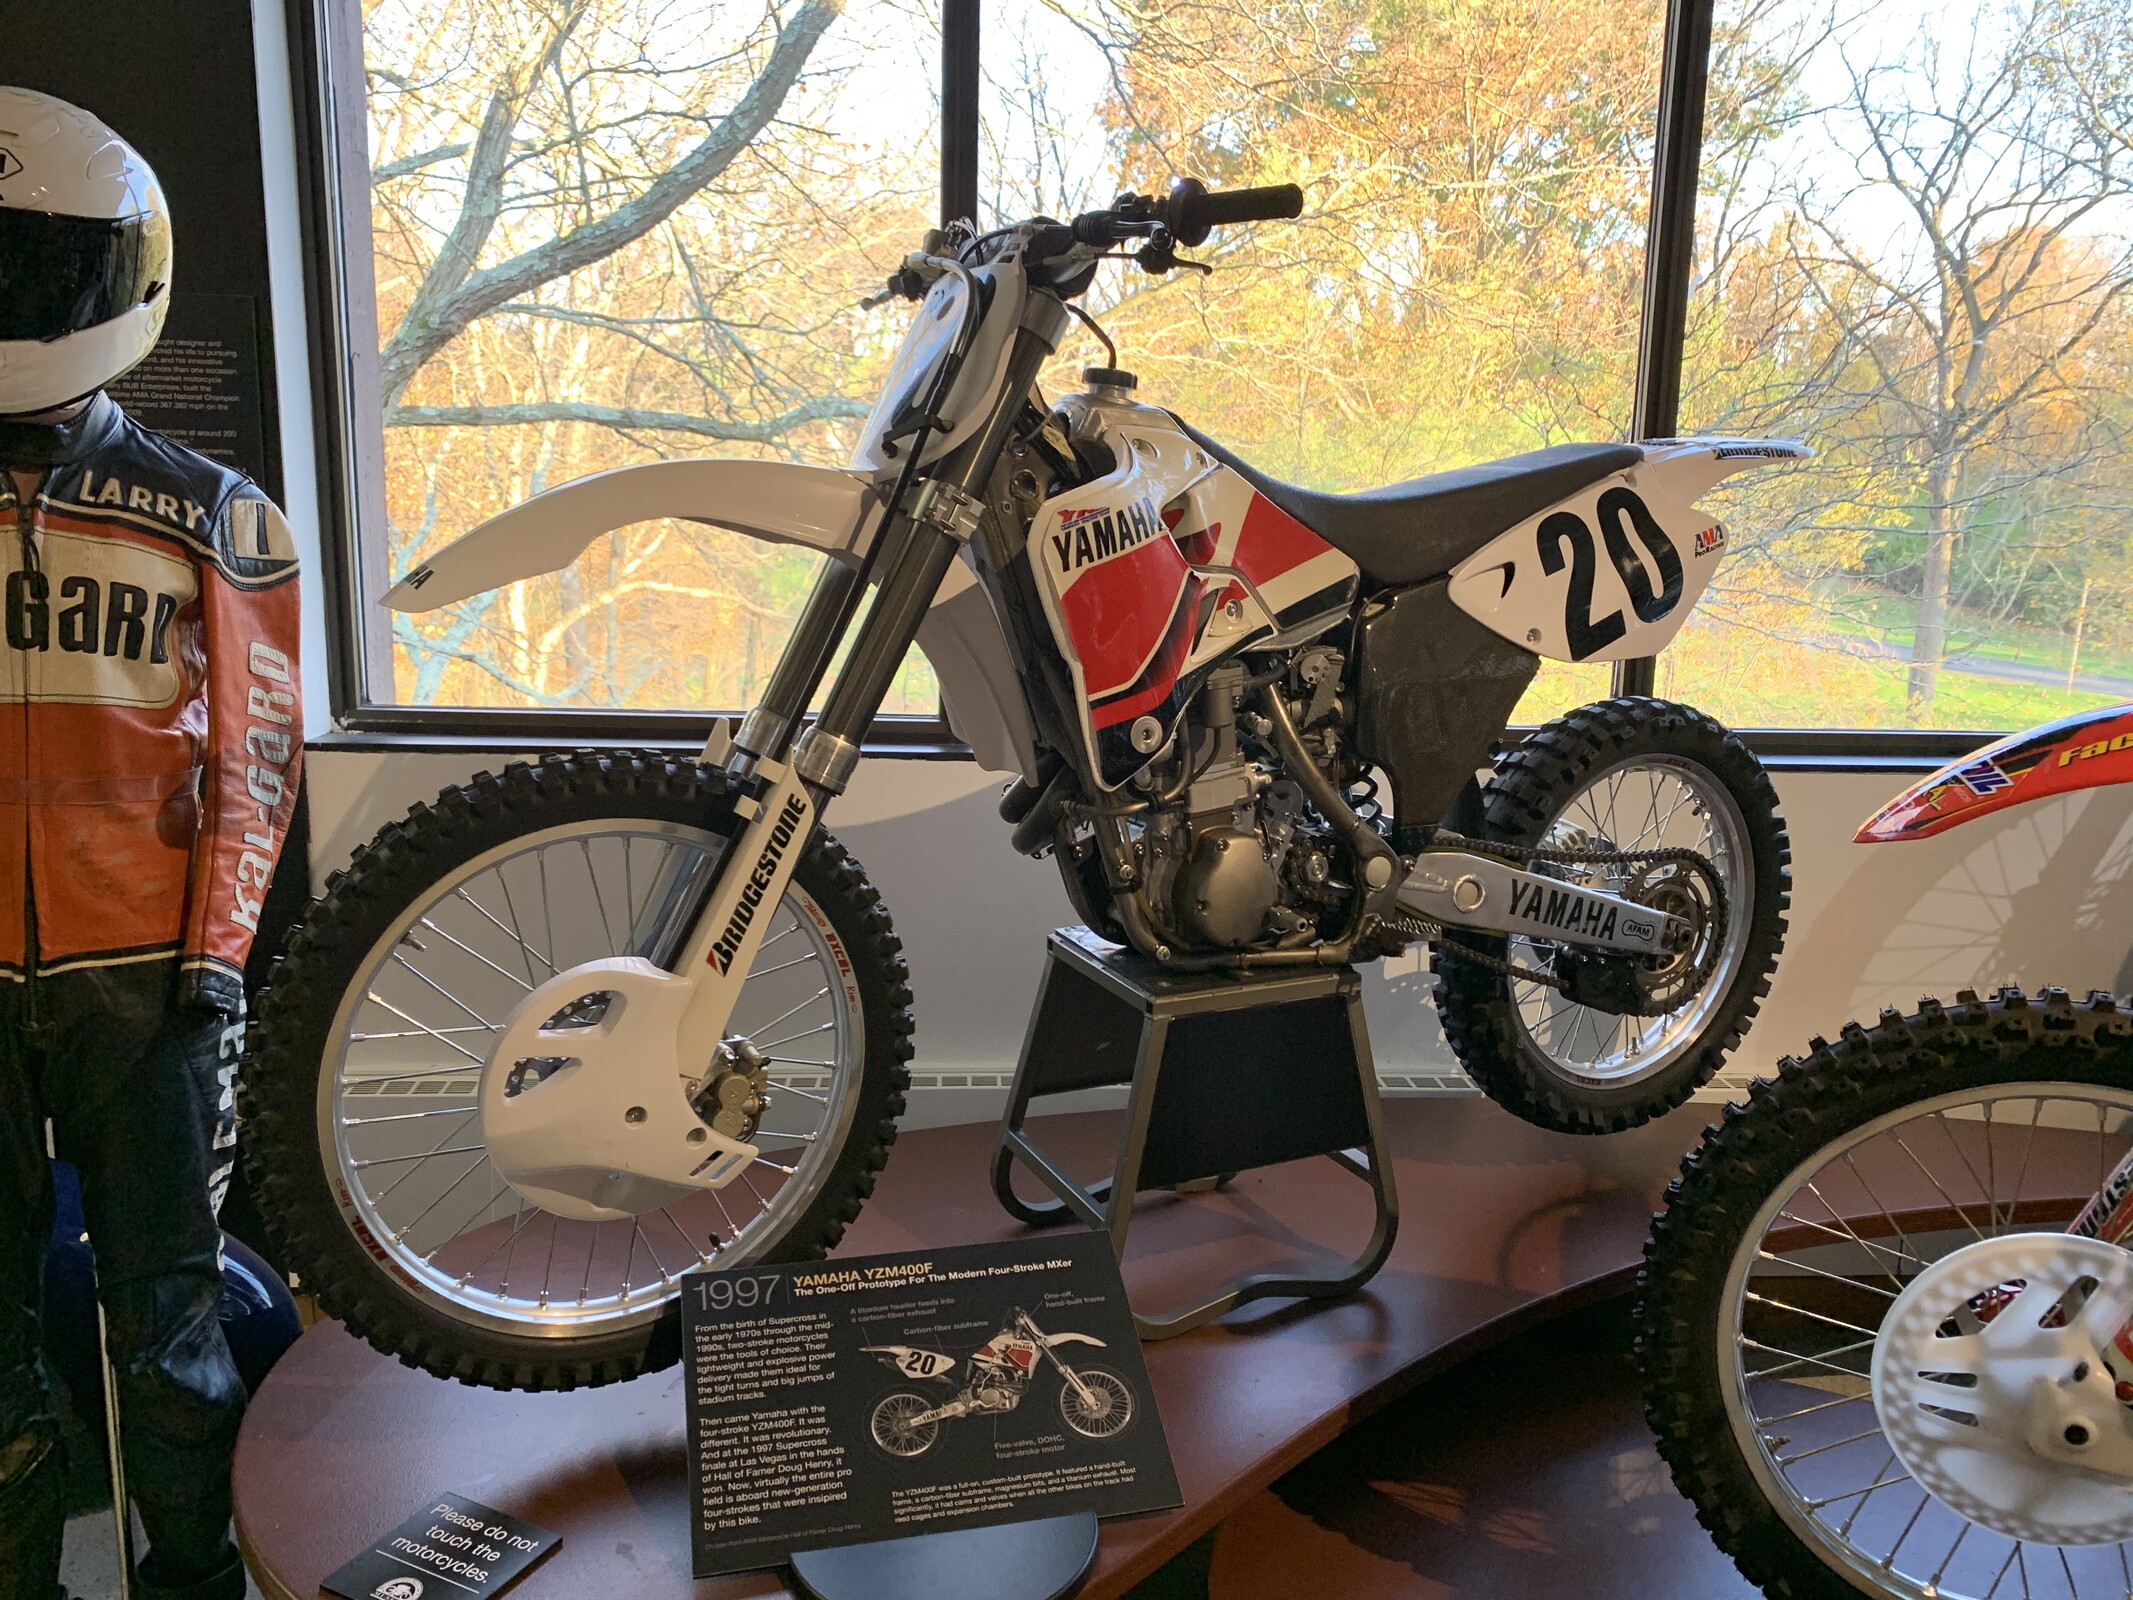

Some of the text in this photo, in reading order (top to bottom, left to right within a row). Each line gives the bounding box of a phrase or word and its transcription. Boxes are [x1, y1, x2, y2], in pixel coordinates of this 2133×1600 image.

[79, 470, 206, 530] LARRY
[1051, 497, 1163, 572] YAMAHA
[1694, 524, 1724, 551] AMA
[1537, 487, 1683, 661] 20
[711, 792, 807, 977] BRIDGESTONE
[1509, 878, 1618, 941] YAMAHA
[1627, 924, 1650, 937] AFAM
[793, 1262, 932, 1287] YAMAHA YZM400F
[793, 1259, 1072, 1296] The One-Off Prototype For The Modern Four-Stroke MXer
[693, 1275, 780, 1311] 1997
[694, 1324, 717, 1332] From
[719, 1322, 734, 1330] the
[735, 1320, 756, 1328] birth
[757, 1318, 766, 1326] of
[768, 1314, 817, 1325] Supercross
[695, 1335, 709, 1343] the
[711, 1332, 733, 1341] early
[735, 1329, 761, 1338] 1970s
[763, 1325, 796, 1335] through
[814, 1321, 834, 1329] mid-
[696, 1332, 828, 1352] 1990s, two-stroke motorcycles
[696, 1342, 826, 1363] were the tools of choice. Their
[696, 1352, 836, 1374] lightweight and explosive power
[697, 1363, 820, 1384] delivery made them ideal for
[905, 1351, 937, 1375] 20
[697, 1371, 834, 1394] the tight turns and big jumps of
[698, 1391, 766, 1405] stadium tracks.
[699, 1416, 825, 1437] four-stroke YZM400F. It was
[700, 1405, 825, 1426] Then came Yamaha with the
[922, 1407, 949, 1422] YAMAHA
[700, 1427, 831, 1448] different. It was revolutionary.
[700, 1438, 827, 1459] And at the 1997 Supercross
[1041, 1444, 1065, 1453] motor
[701, 1446, 844, 1471] finale at Las Vegas in the hands
[701, 1457, 842, 1483] of Hall of Famer Doug Henry, it
[702, 1468, 852, 1494] won. Now, virtually the entire pro
[703, 1481, 843, 1505] field is aboard new-generation
[703, 1491, 847, 1517] four-strokes that were insipired
[430, 1503, 539, 1553] Please do not
[704, 1516, 761, 1530] by this bike.
[425, 1524, 501, 1562] touch the
[391, 1536, 488, 1584] motorcycles.
